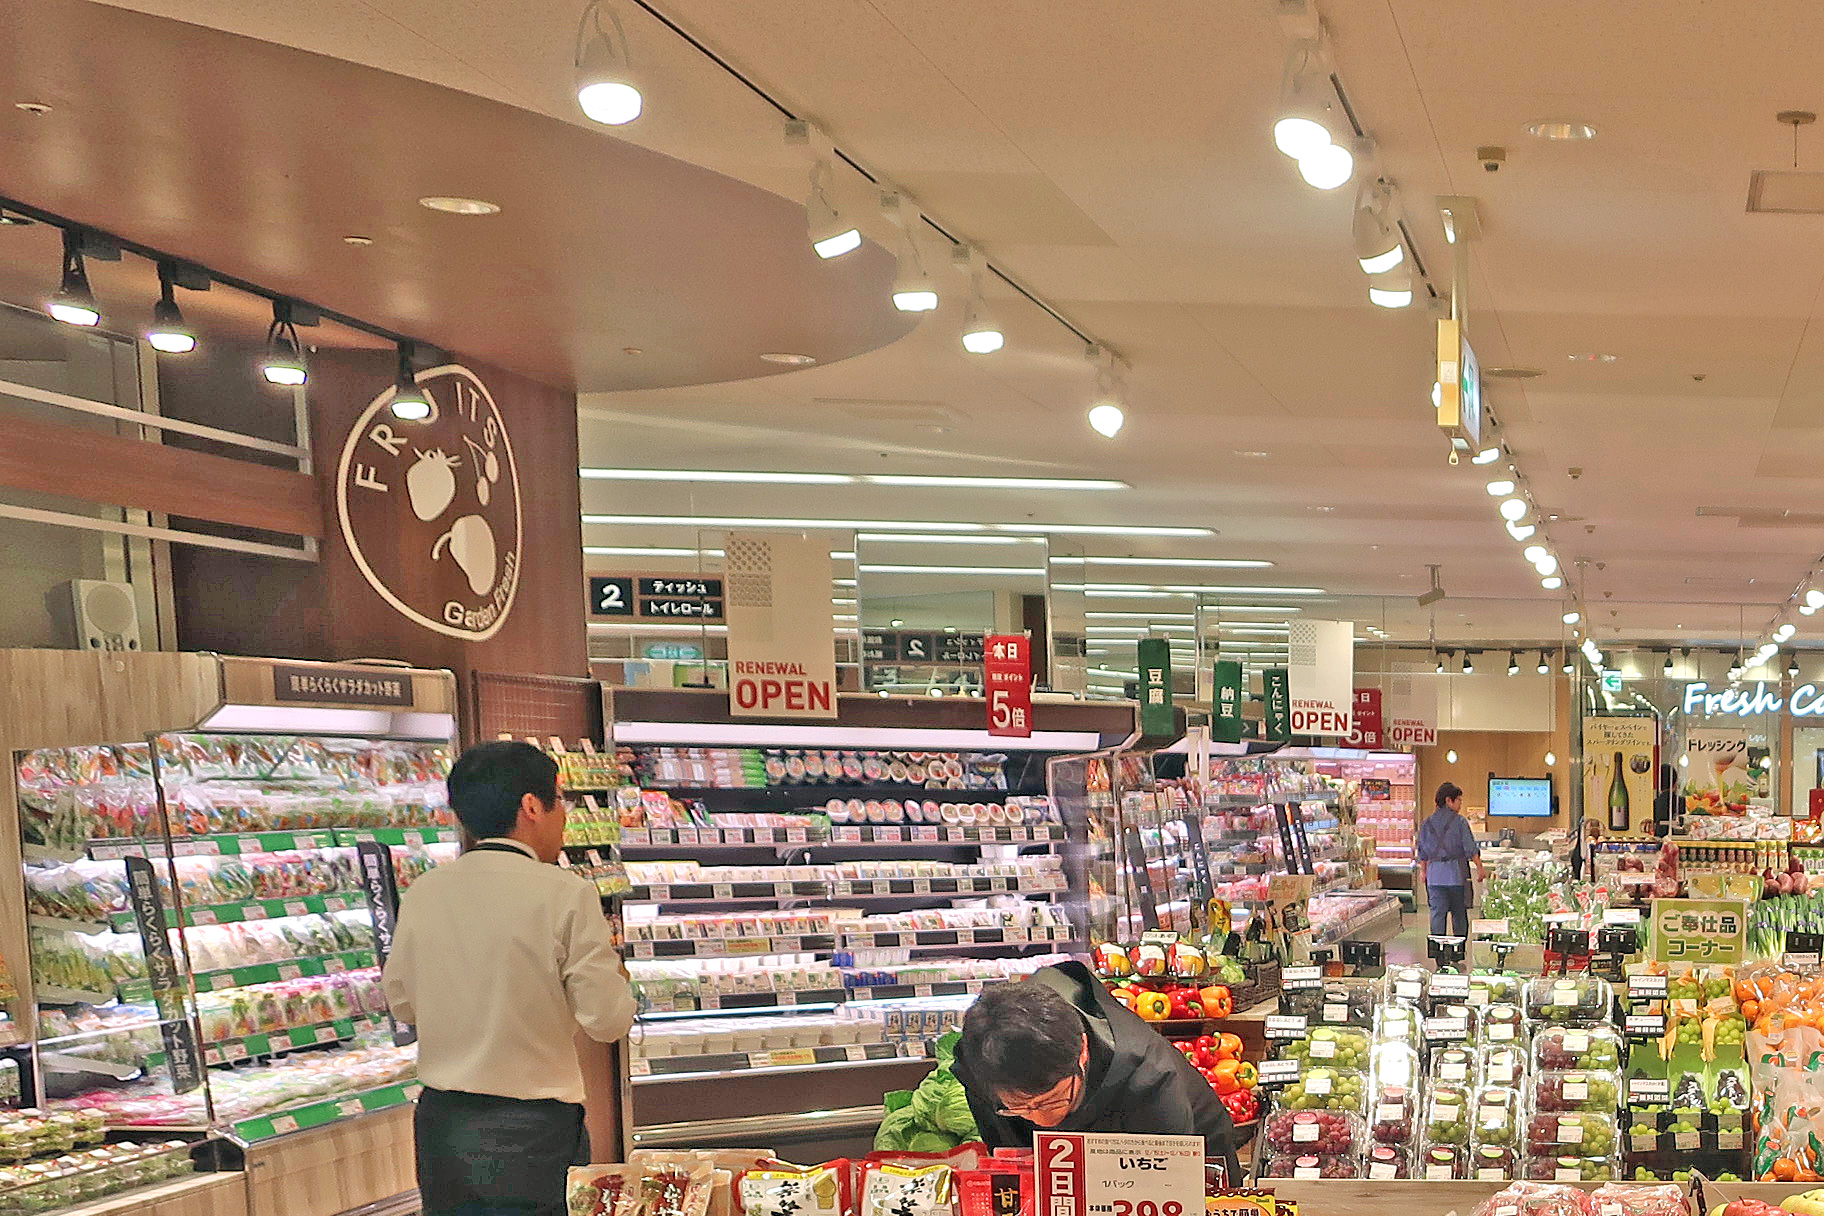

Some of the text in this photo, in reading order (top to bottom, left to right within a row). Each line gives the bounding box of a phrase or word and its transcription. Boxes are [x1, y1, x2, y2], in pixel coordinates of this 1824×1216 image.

[600, 583, 625, 609] 2
[653, 581, 707, 594] ティッシュ
[651, 601, 714, 615] トイレロール
[992, 642, 1018, 659] 本日
[735, 661, 806, 675] RENEWAL
[735, 679, 830, 710] OPEN
[1147, 668, 1164, 705] 豆腐
[1219, 686, 1235, 718] 納豆
[1271, 675, 1283, 734] こんにゃく
[1292, 700, 1335, 709] RENEWAL
[1683, 681, 1783, 718] Fresh
[992, 690, 1025, 728] 5倍
[1291, 711, 1348, 731] OPEN
[1393, 719, 1424, 727] RENEWAL
[1392, 727, 1435, 743] OPEN
[1688, 739, 1747, 752] ドレッシング
[1663, 914, 1737, 934] ご奉仕品
[1667, 938, 1735, 957] コーナー
[1119, 1157, 1169, 1171] いちご
[1102, 1180, 1135, 1189] 1パック
